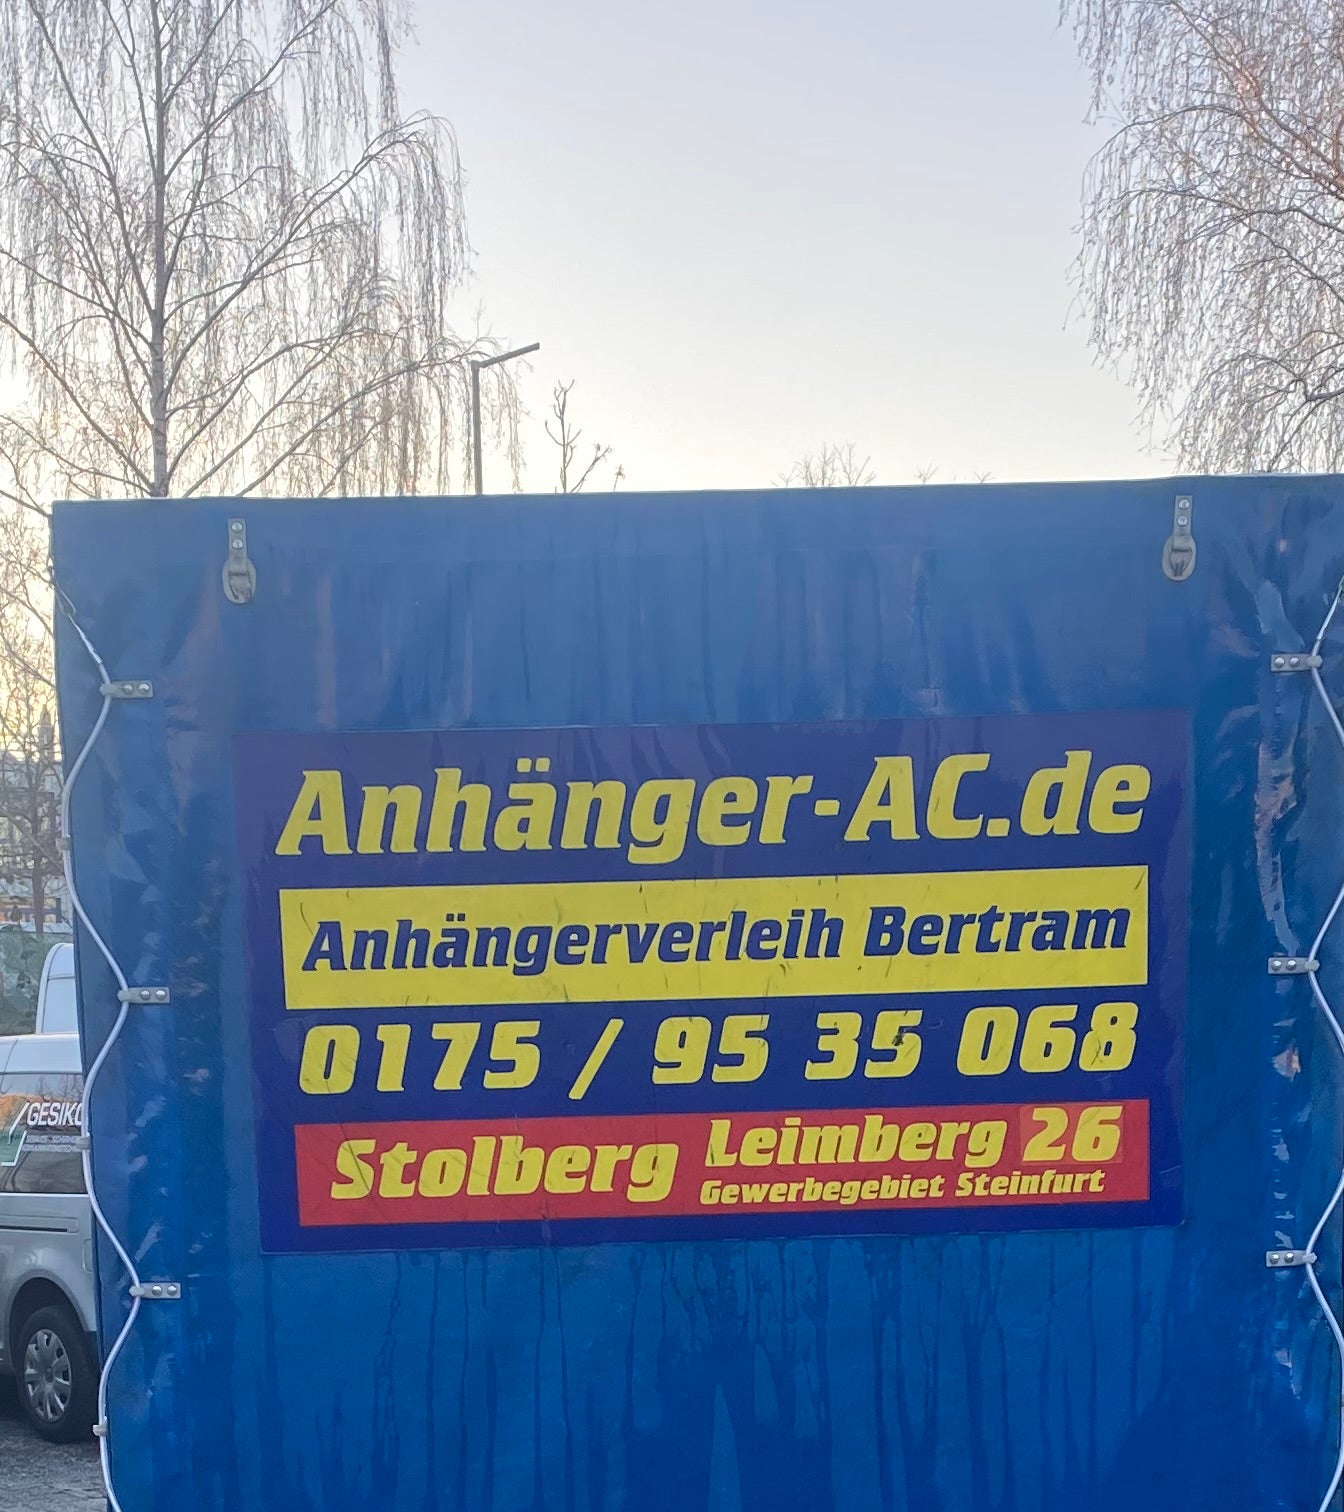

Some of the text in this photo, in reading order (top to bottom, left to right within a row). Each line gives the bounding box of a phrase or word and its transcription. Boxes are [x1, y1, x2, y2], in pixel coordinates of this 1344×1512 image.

[275, 749, 1154, 864] Anhänger-AC.de
[301, 904, 1131, 977] Anhängerverleih Bertram
[299, 1002, 1140, 1100] 0175 / 95 35 068
[329, 1106, 1124, 1202] Stolberg Leimberg 26
[699, 1168, 1106, 1206] Gewerbegebiet Steinfurt
